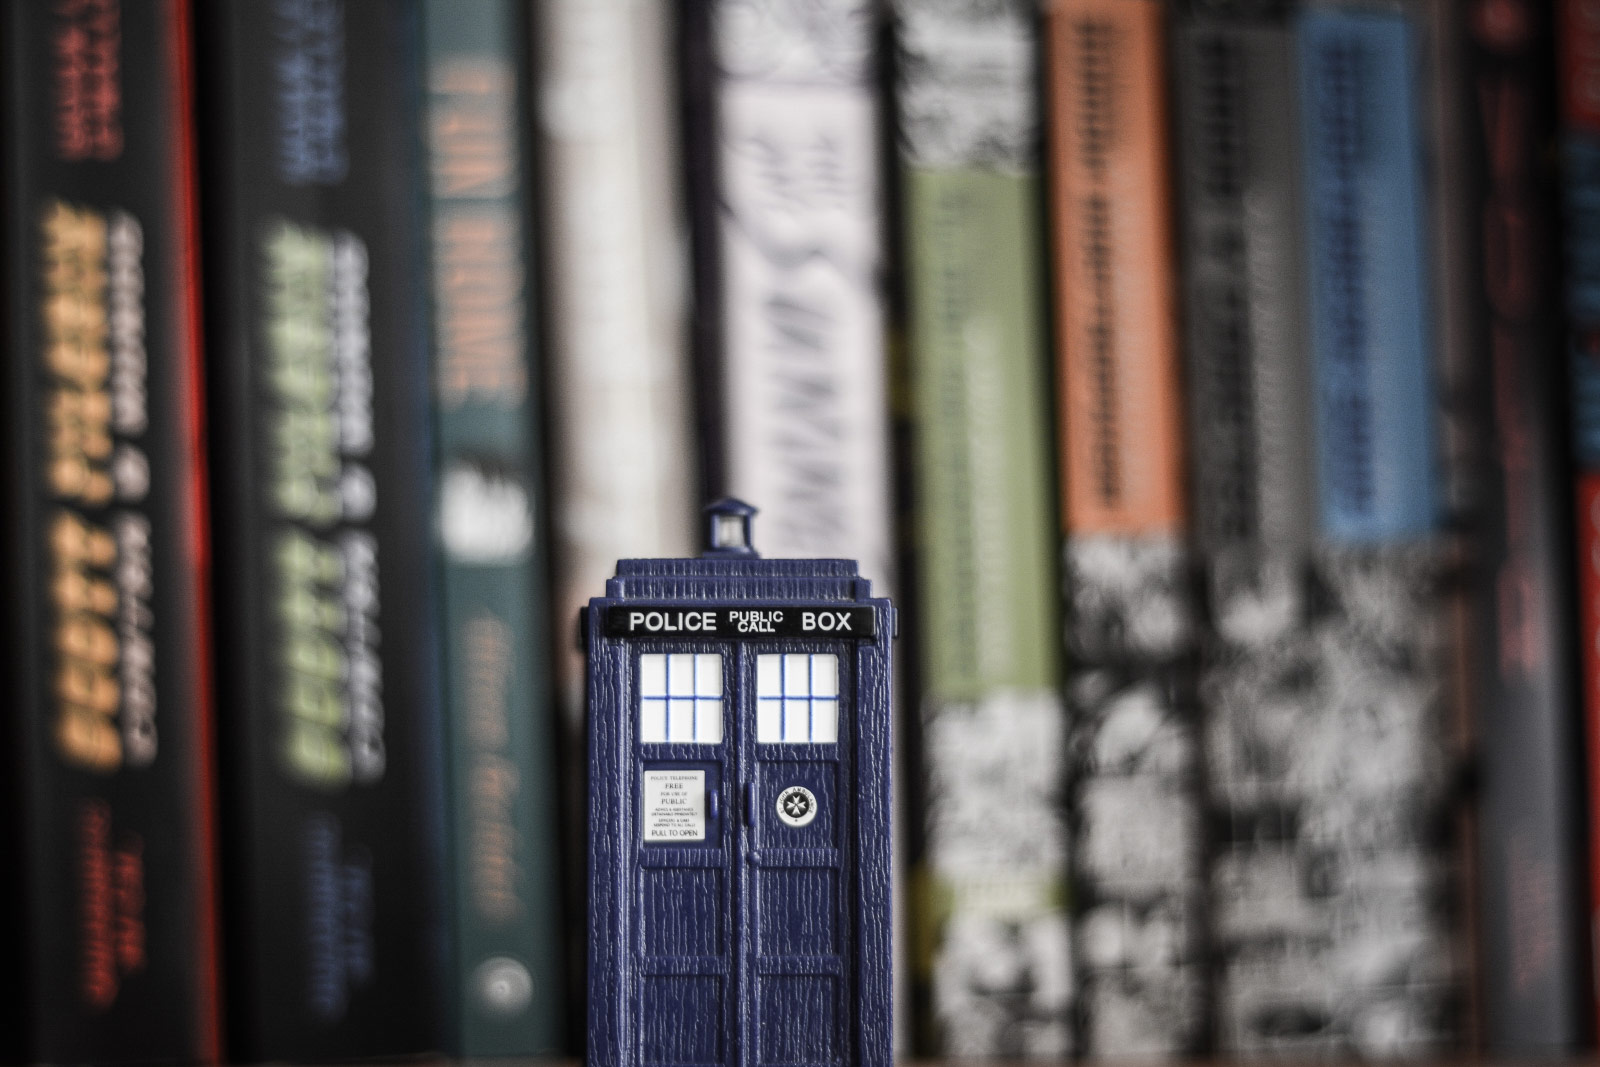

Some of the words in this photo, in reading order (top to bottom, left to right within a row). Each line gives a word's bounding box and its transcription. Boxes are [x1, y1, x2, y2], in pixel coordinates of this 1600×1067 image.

[629, 612, 717, 631] POLICE
[729, 611, 784, 622] PUBLIC
[801, 612, 852, 631] BOX
[737, 621, 776, 632] CALL
[651, 829, 667, 837] PULL
[669, 829, 678, 837] TO
[679, 829, 698, 837] OPEN
